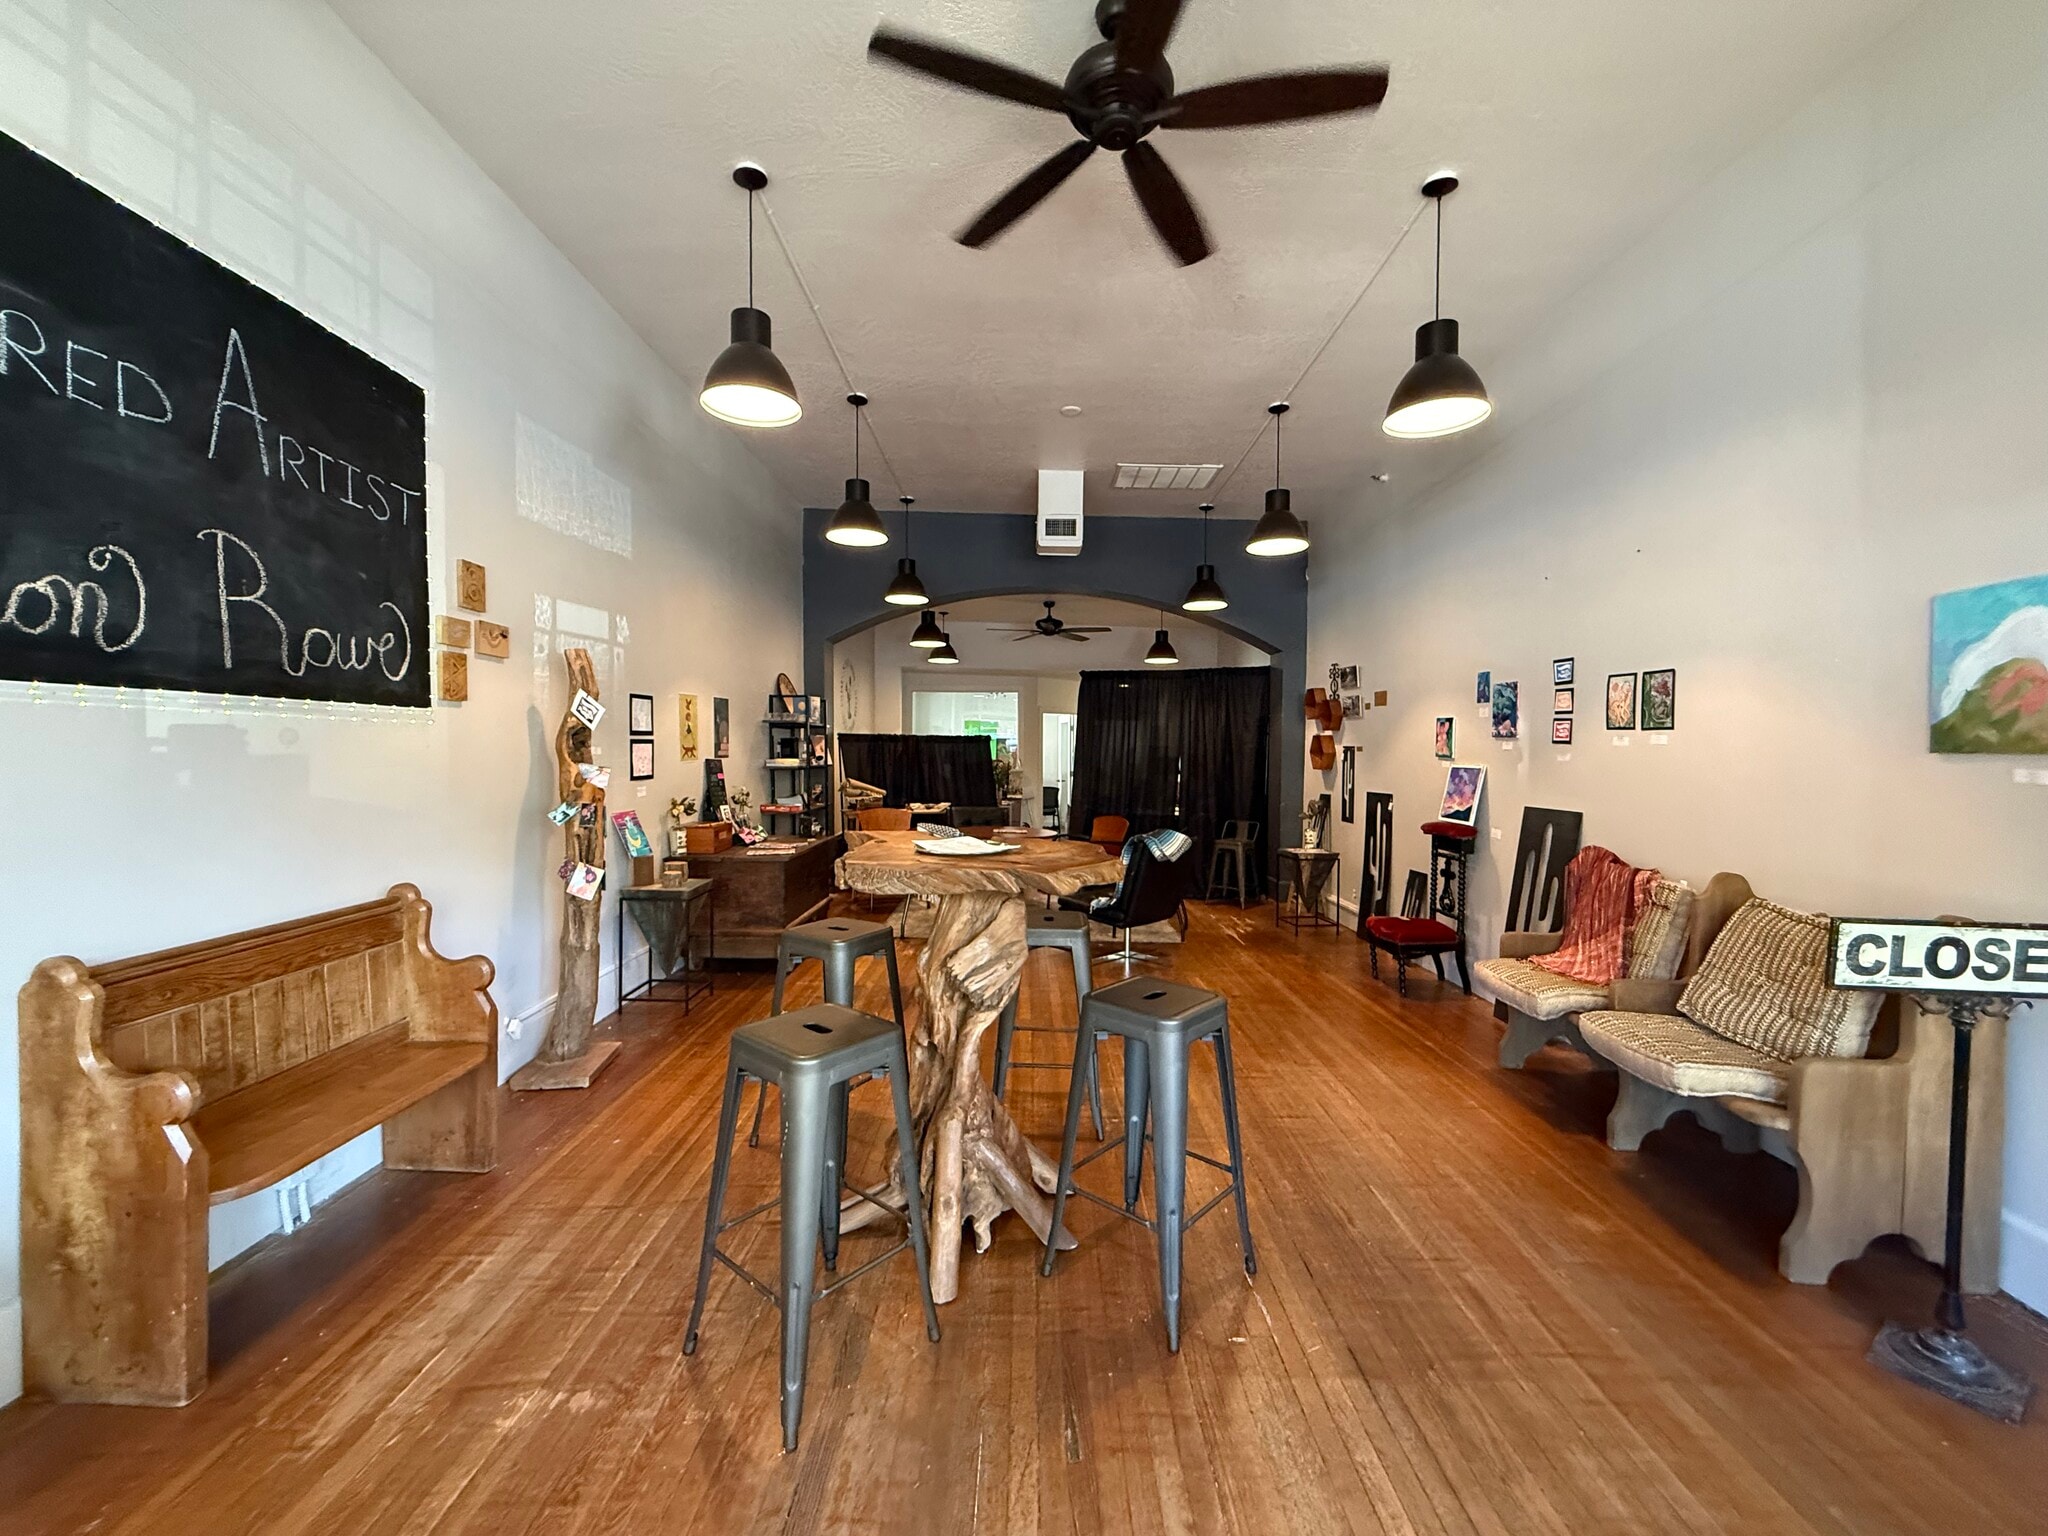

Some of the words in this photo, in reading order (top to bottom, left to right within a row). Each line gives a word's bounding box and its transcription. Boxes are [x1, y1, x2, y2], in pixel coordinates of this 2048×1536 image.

[208, 327, 421, 525] ARTIST
[196, 528, 411, 682] Rowe
[1845, 932, 2048, 982] CLOSE
